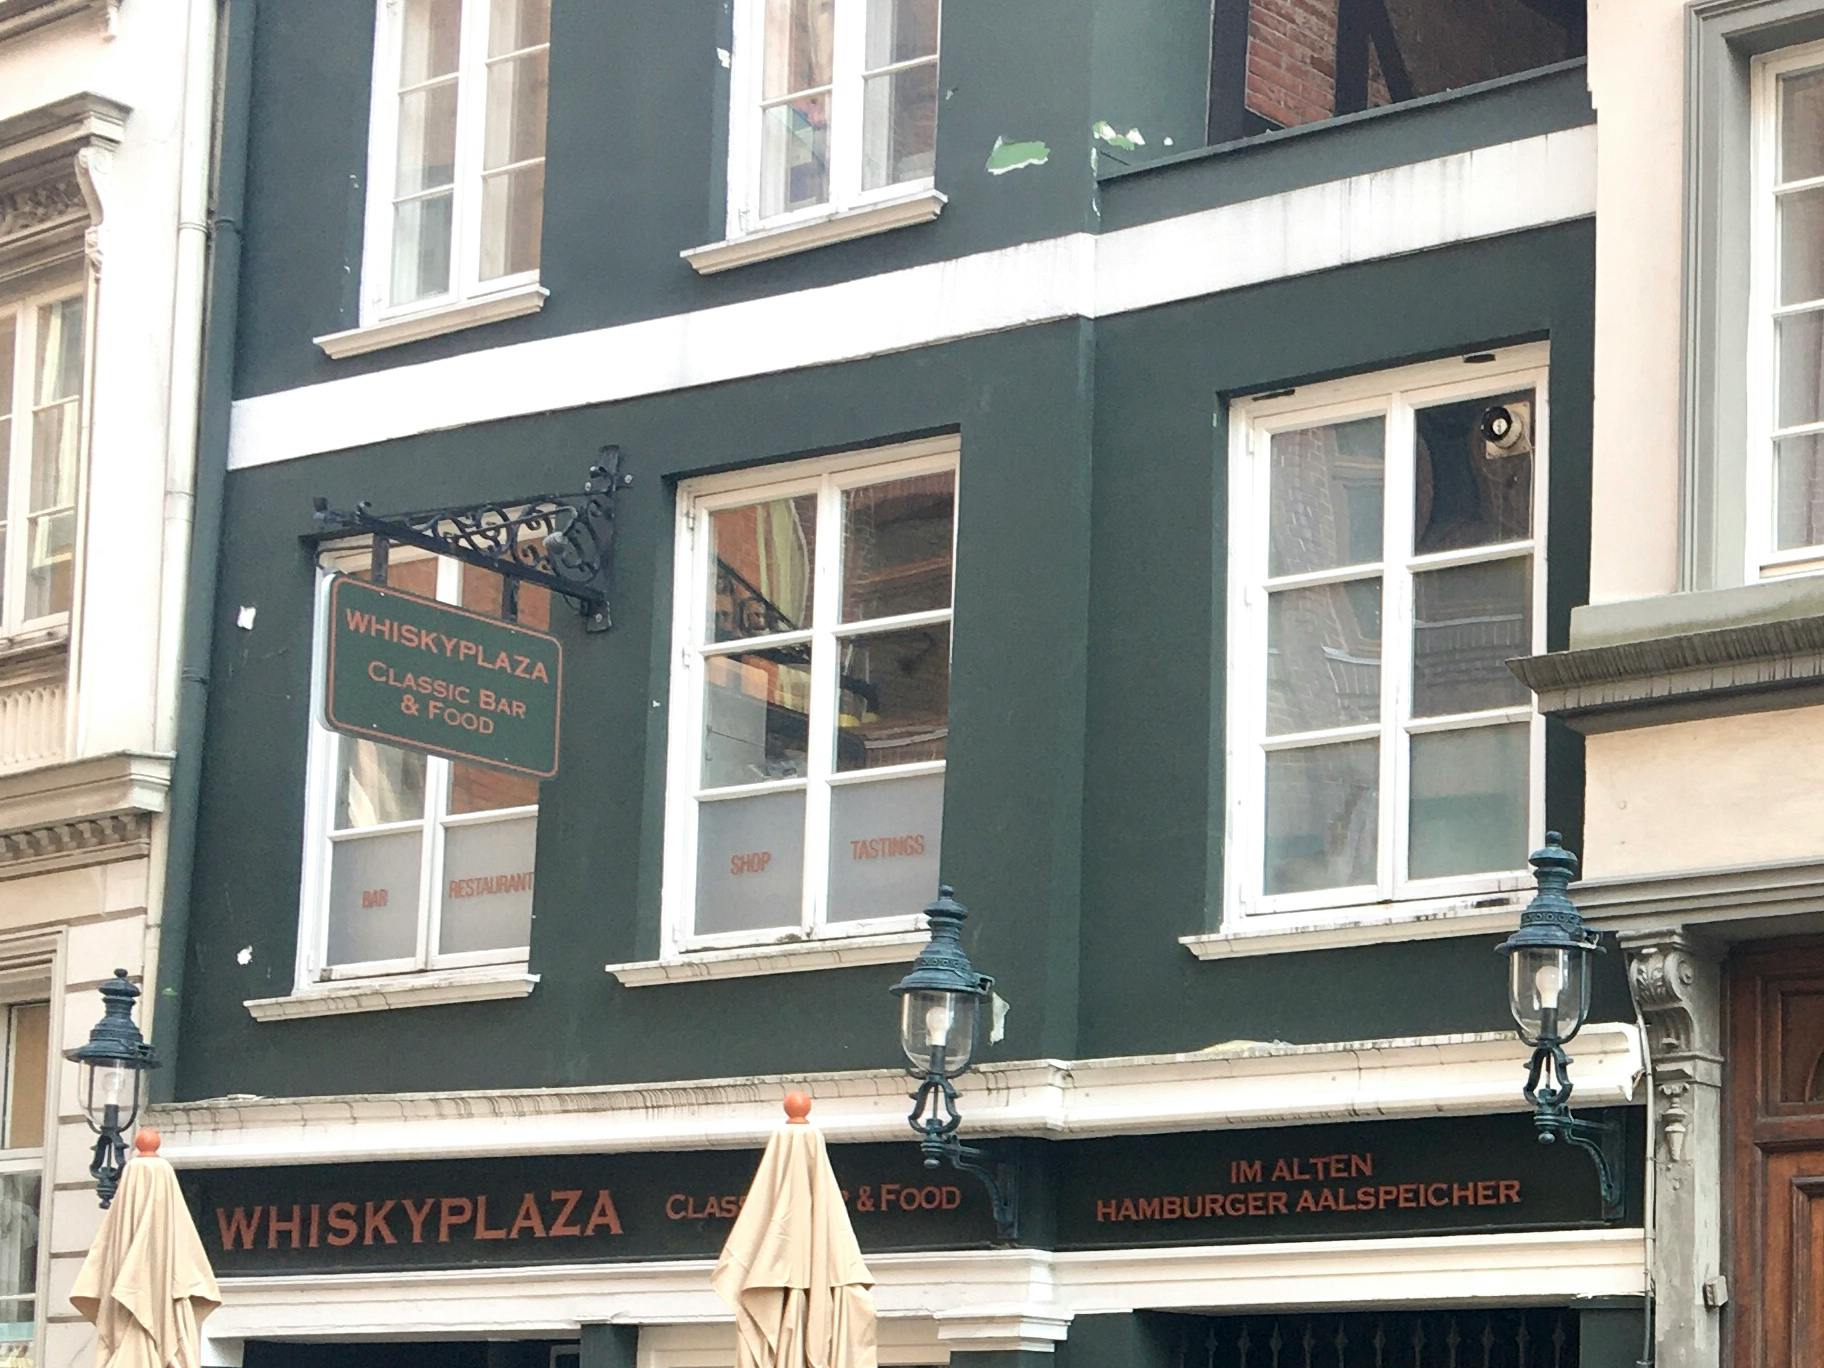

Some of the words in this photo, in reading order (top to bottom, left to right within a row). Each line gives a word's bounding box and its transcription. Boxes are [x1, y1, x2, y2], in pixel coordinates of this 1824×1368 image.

[347, 609, 549, 684] WHISKYPLAZA
[368, 661, 470, 704] CLASSIC
[479, 689, 527, 719] BAR
[400, 693, 420, 717] &
[429, 700, 495, 735] FOOD
[730, 851, 772, 876] SHOP
[851, 834, 926, 861] TASTINGS
[361, 888, 389, 909] BAR
[448, 871, 535, 900] RESTAURANT
[1230, 1159, 1263, 1185] IM
[1271, 1152, 1374, 1182] ALTEN
[856, 1185, 875, 1212] &
[879, 1183, 962, 1212] FOOD
[1096, 1190, 1290, 1223] HAMBURGER
[1296, 1178, 1522, 1213] AALSPEICHER
[216, 1188, 624, 1251] WHISKYPLAZA
